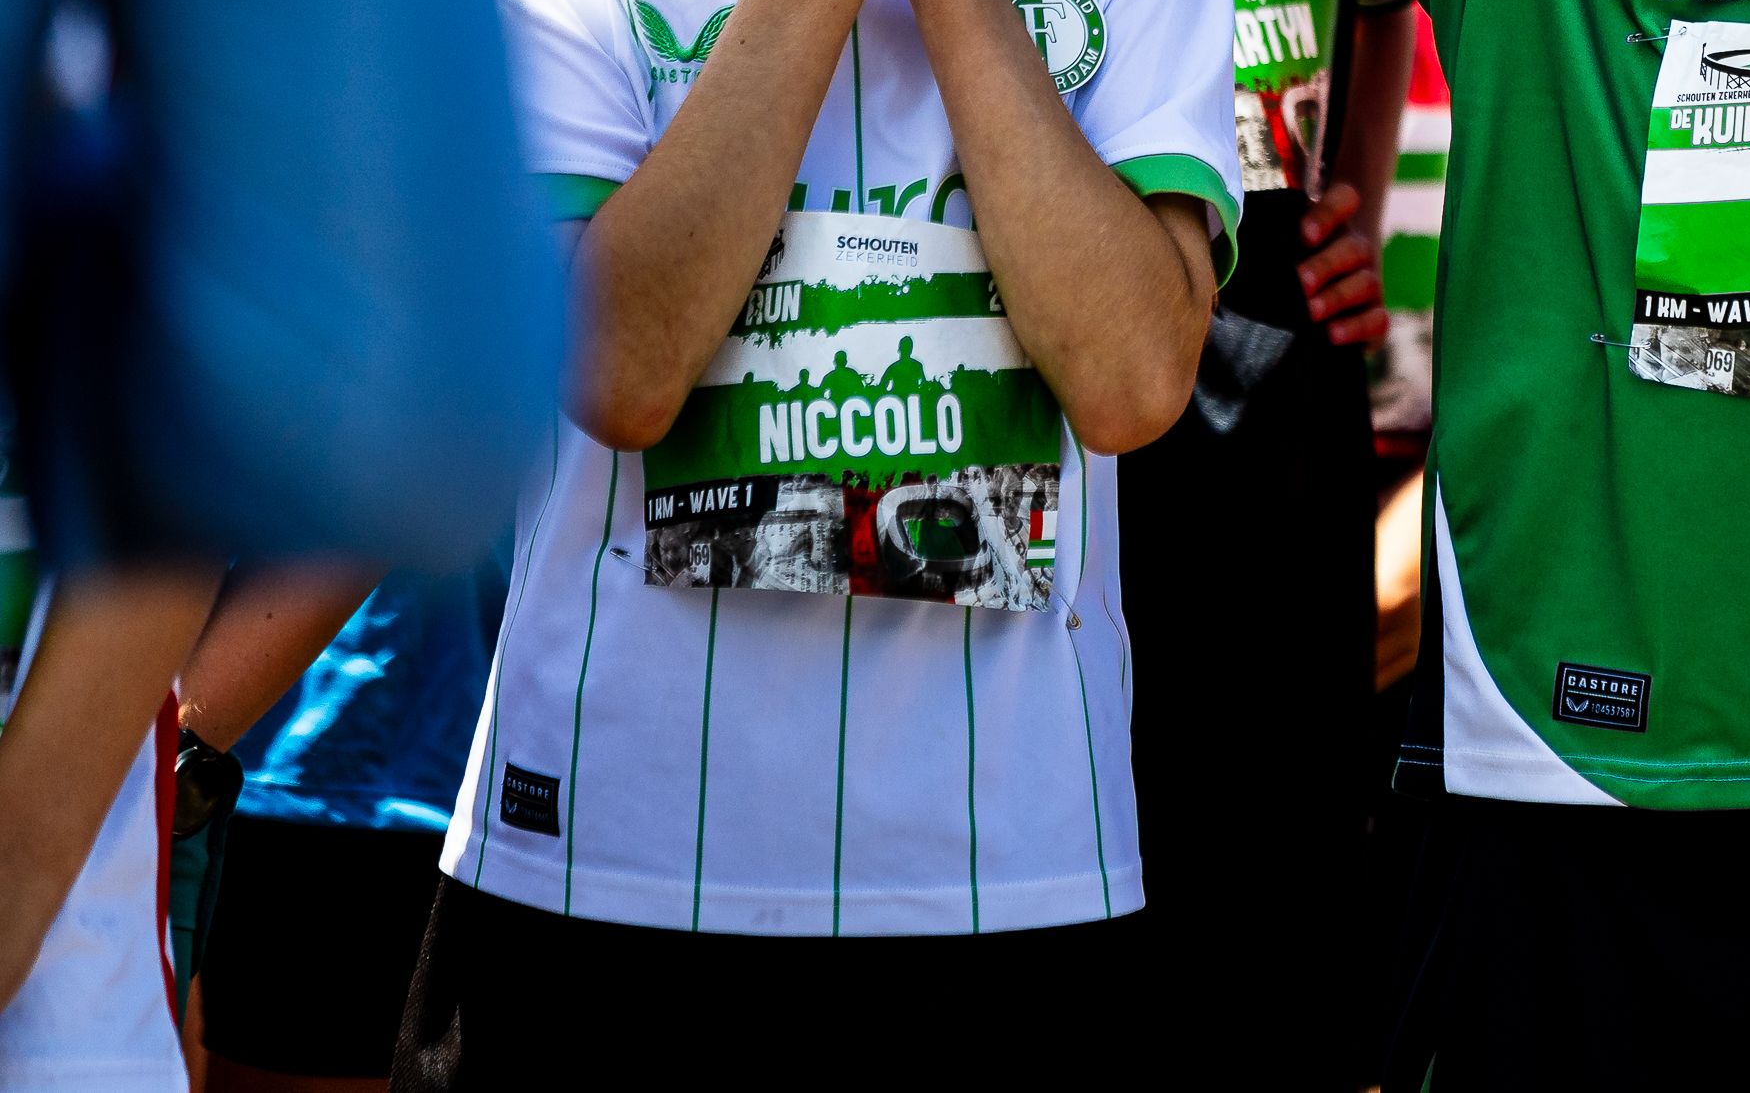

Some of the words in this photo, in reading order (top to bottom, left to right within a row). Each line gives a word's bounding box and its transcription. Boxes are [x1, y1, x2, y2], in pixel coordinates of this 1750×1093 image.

[650, 66, 701, 84] CAST
[1676, 91, 1716, 103] SCHOUTEN
[1670, 108, 1694, 130] DE
[836, 236, 919, 256] SCHOUTEN
[835, 250, 918, 267] ZEKERHEID
[1644, 296, 1652, 317] 1
[1657, 296, 1687, 319] KM
[759, 393, 964, 464] NICCOLO
[648, 499, 653, 522] 1
[655, 495, 674, 521] KM
[689, 486, 739, 514] WAVE
[745, 482, 753, 507] 1
[1568, 675, 1639, 696] CASTORE
[506, 777, 550, 799] CASTORE
